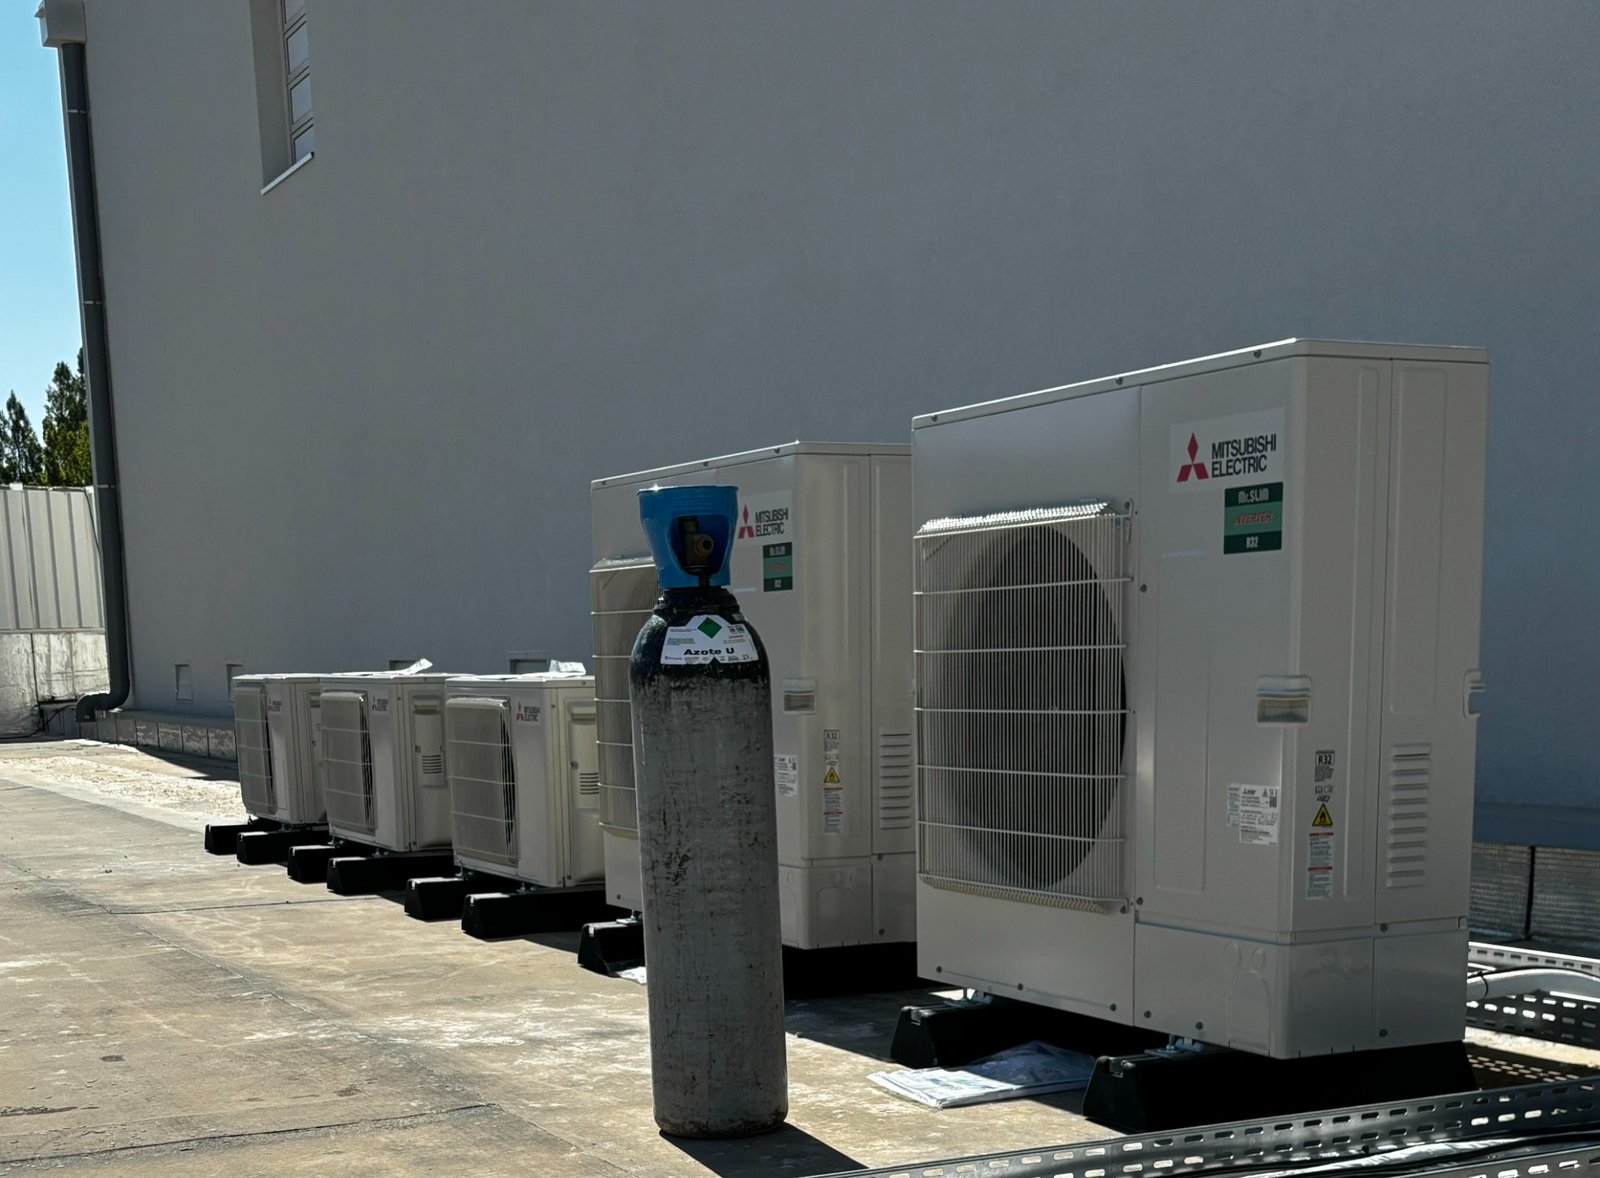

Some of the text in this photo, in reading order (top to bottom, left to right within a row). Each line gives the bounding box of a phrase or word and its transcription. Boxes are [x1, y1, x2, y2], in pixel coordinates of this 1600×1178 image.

[1211, 433, 1277, 460] MITSUBISHI
[1211, 454, 1268, 479] ELECTRIC
[755, 507, 789, 524] MITSUBISHI
[755, 522, 785, 537] ELECTRIC
[1246, 536, 1259, 549] R32
[683, 647, 722, 656] Azote
[1318, 754, 1333, 765] R32
